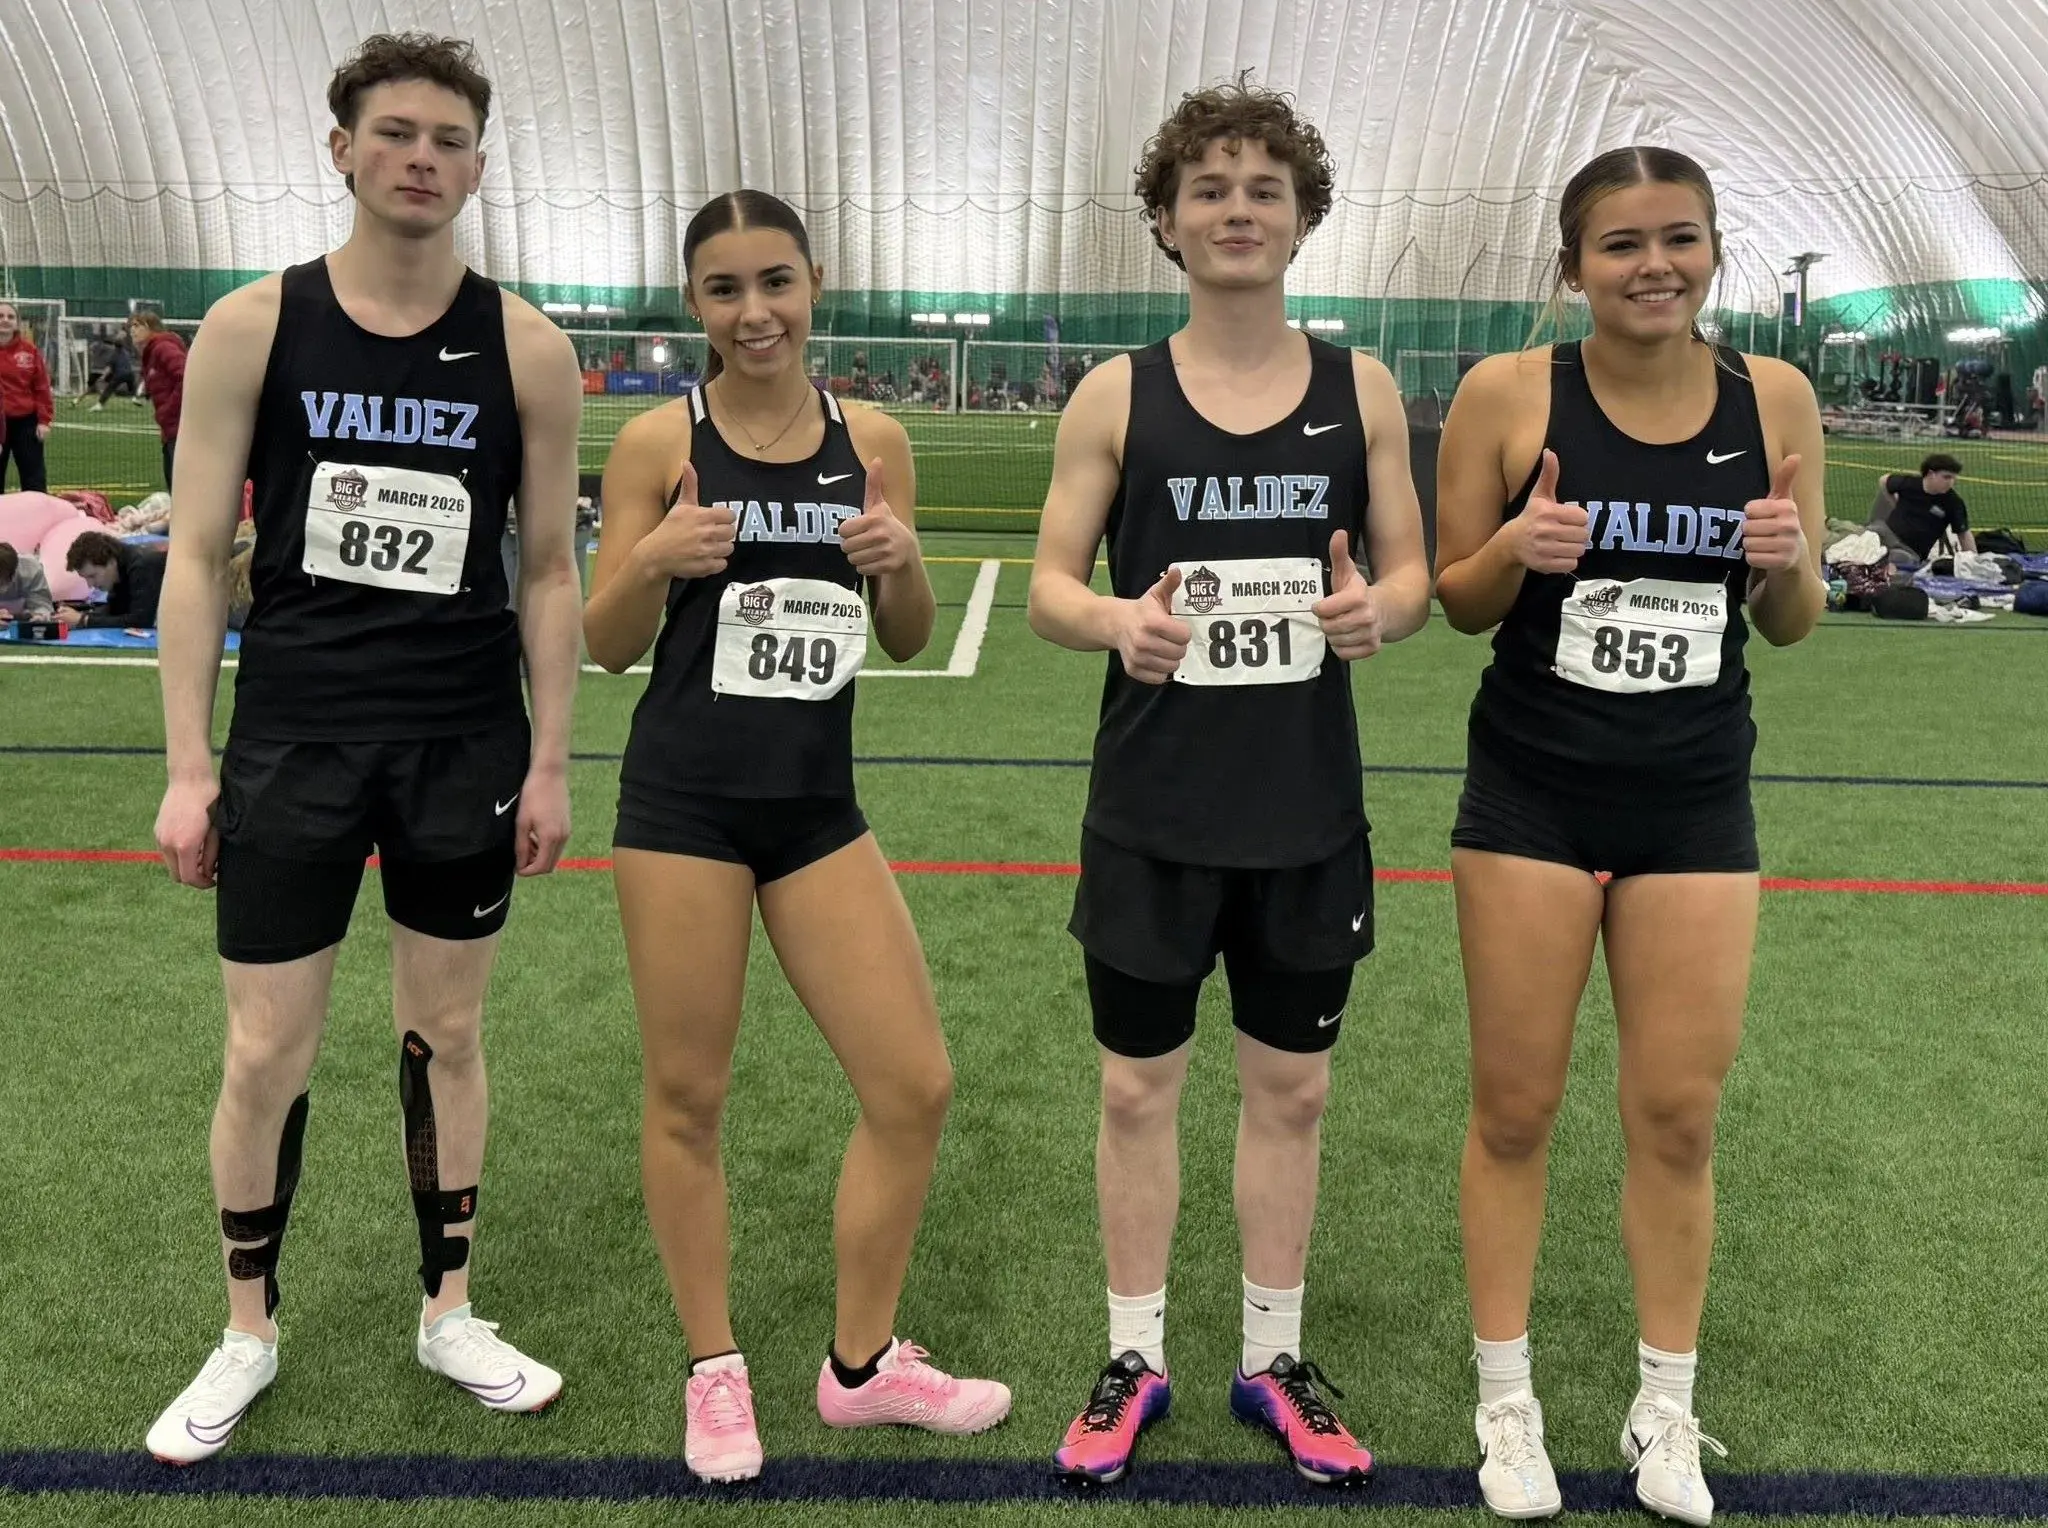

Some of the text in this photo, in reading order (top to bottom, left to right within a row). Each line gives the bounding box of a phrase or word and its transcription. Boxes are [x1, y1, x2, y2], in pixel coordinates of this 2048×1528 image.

[301, 391, 479, 449] VALDEZ
[335, 481, 362, 496] BIG C
[378, 488, 465, 512] MARCH 2026
[1167, 475, 1330, 520] VALDEZ
[712, 501, 862, 544] VALDE
[339, 520, 434, 575] 832
[1190, 582, 1215, 596] BIG C
[1232, 579, 1317, 597] MARCH 2026
[1608, 592, 1616, 602] C
[743, 595, 769, 609] BIG C
[783, 599, 862, 618] MARCH 2026
[1629, 594, 1679, 613] MARCH
[1682, 601, 1719, 617] 2026
[1208, 618, 1291, 669] 831
[1591, 626, 1690, 683] 853
[748, 633, 837, 685] 849
